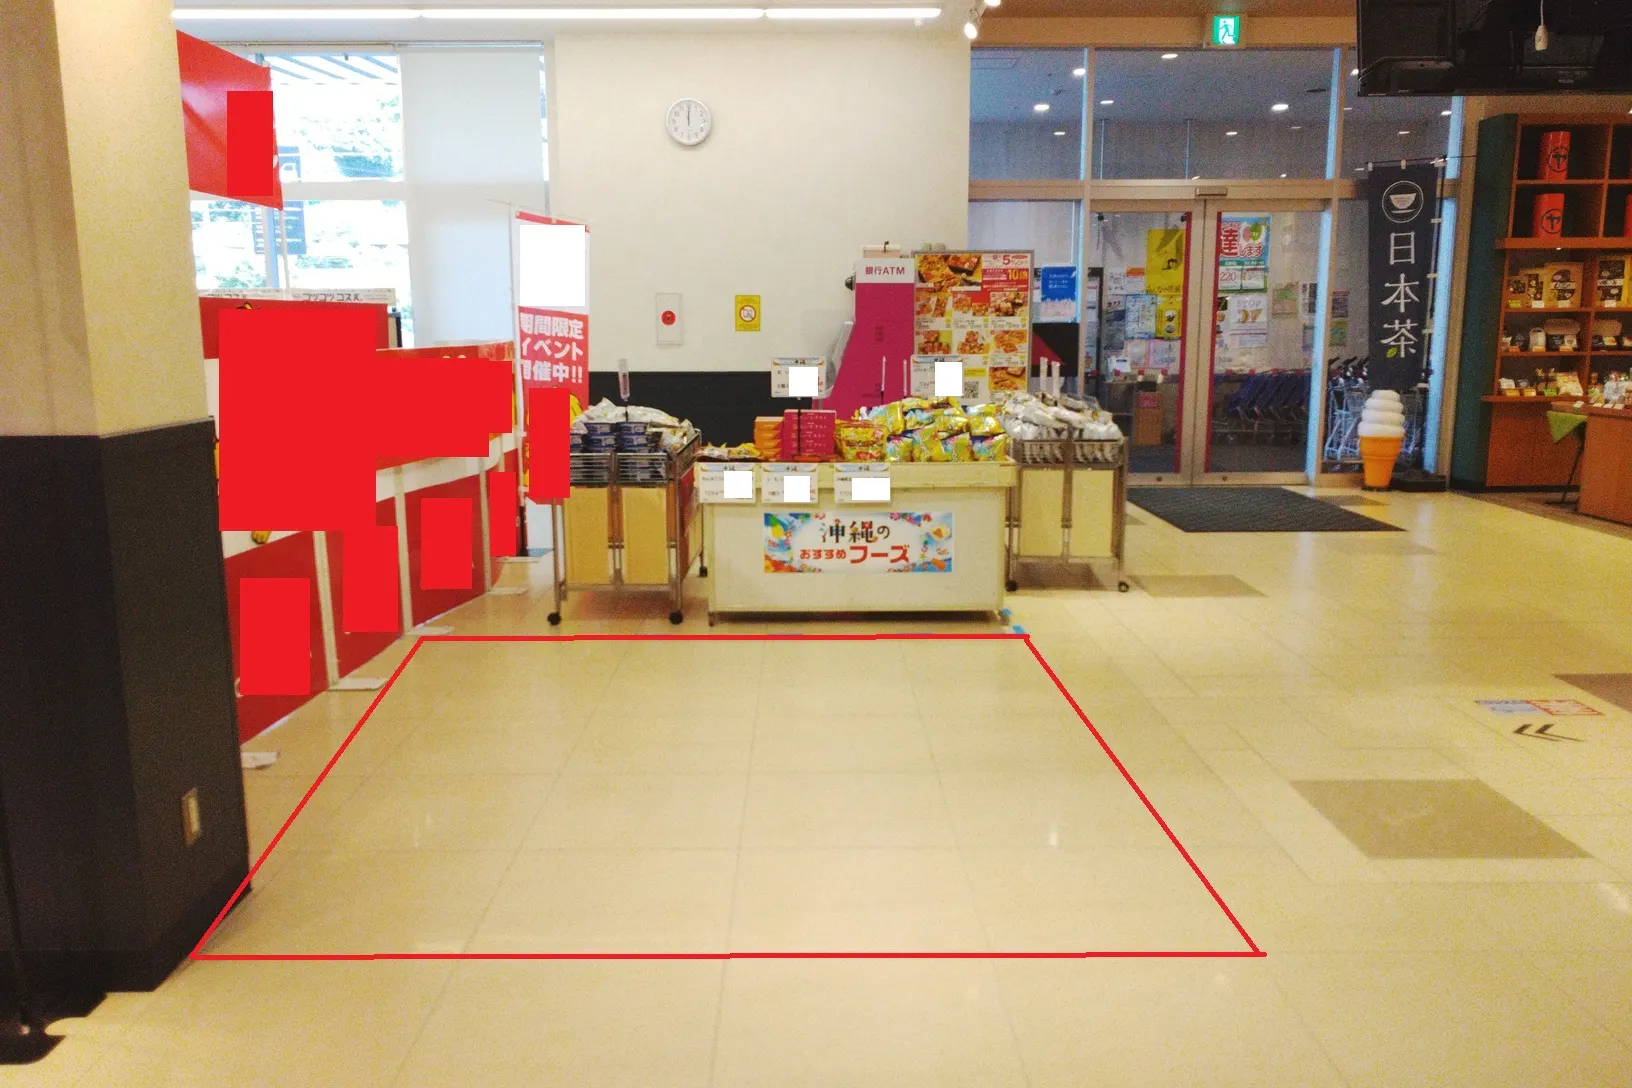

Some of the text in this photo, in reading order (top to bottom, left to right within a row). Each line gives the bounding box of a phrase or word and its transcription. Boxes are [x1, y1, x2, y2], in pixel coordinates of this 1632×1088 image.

[865, 266, 905, 275] 銀行ATM
[1380, 231, 1420, 358] 日本茶
[819, 518, 891, 544] 沖縄の
[800, 544, 911, 564] おすすめフーズ
